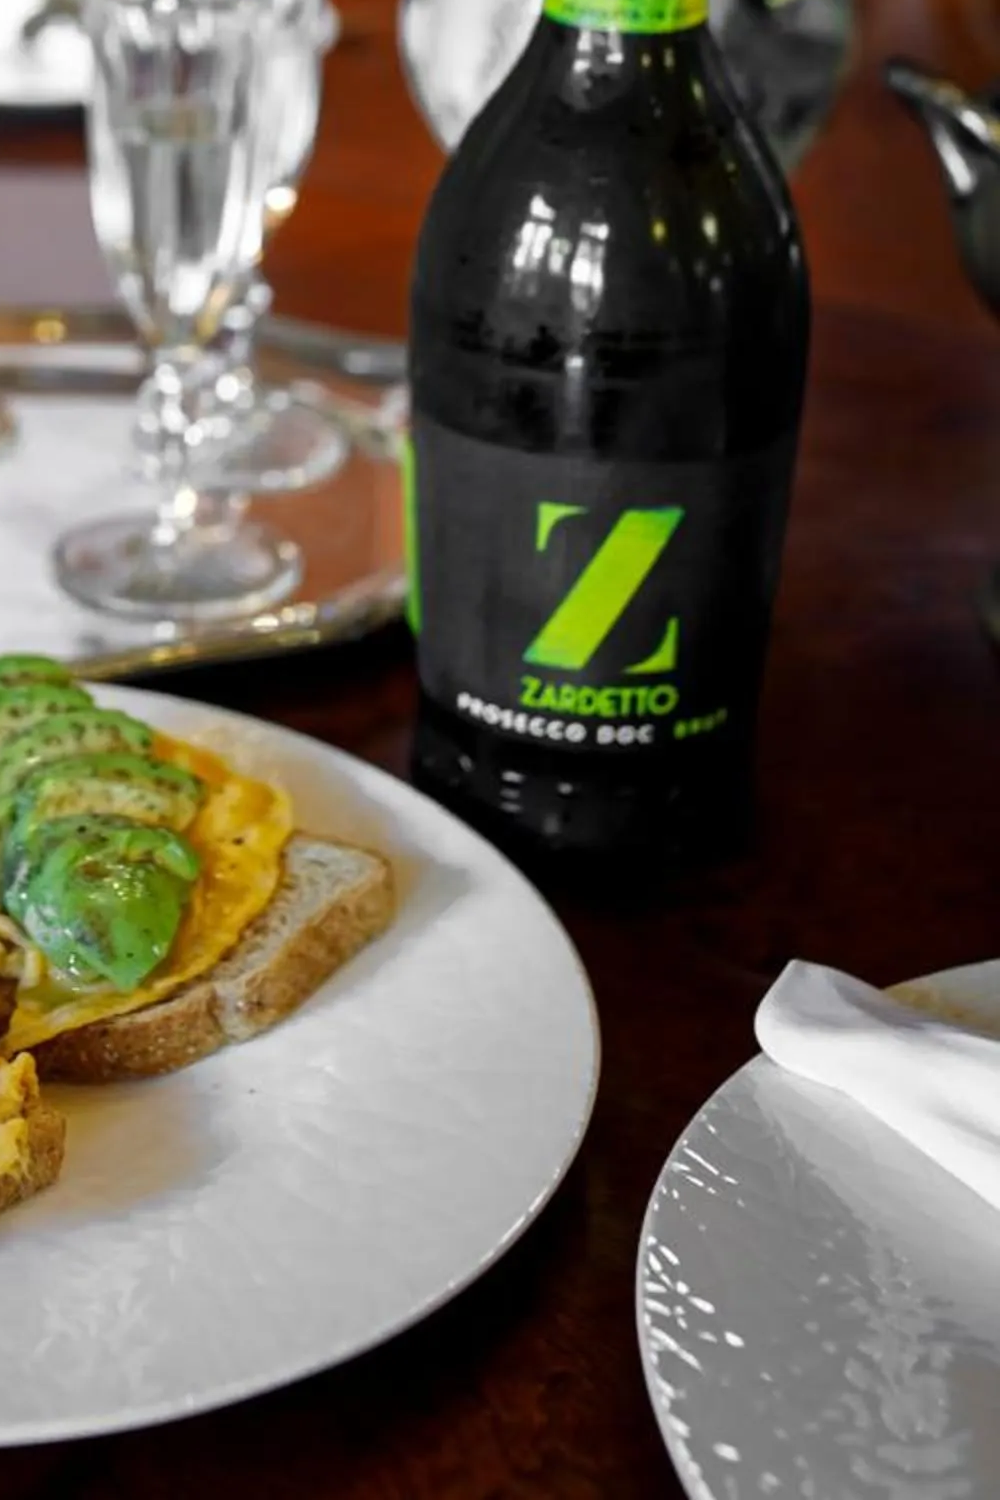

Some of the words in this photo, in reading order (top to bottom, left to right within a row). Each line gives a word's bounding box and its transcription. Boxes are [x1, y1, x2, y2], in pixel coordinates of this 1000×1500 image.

[522, 502, 685, 673] Z
[456, 692, 587, 743] PROSECCO
[520, 677, 679, 717] ZARDETTO
